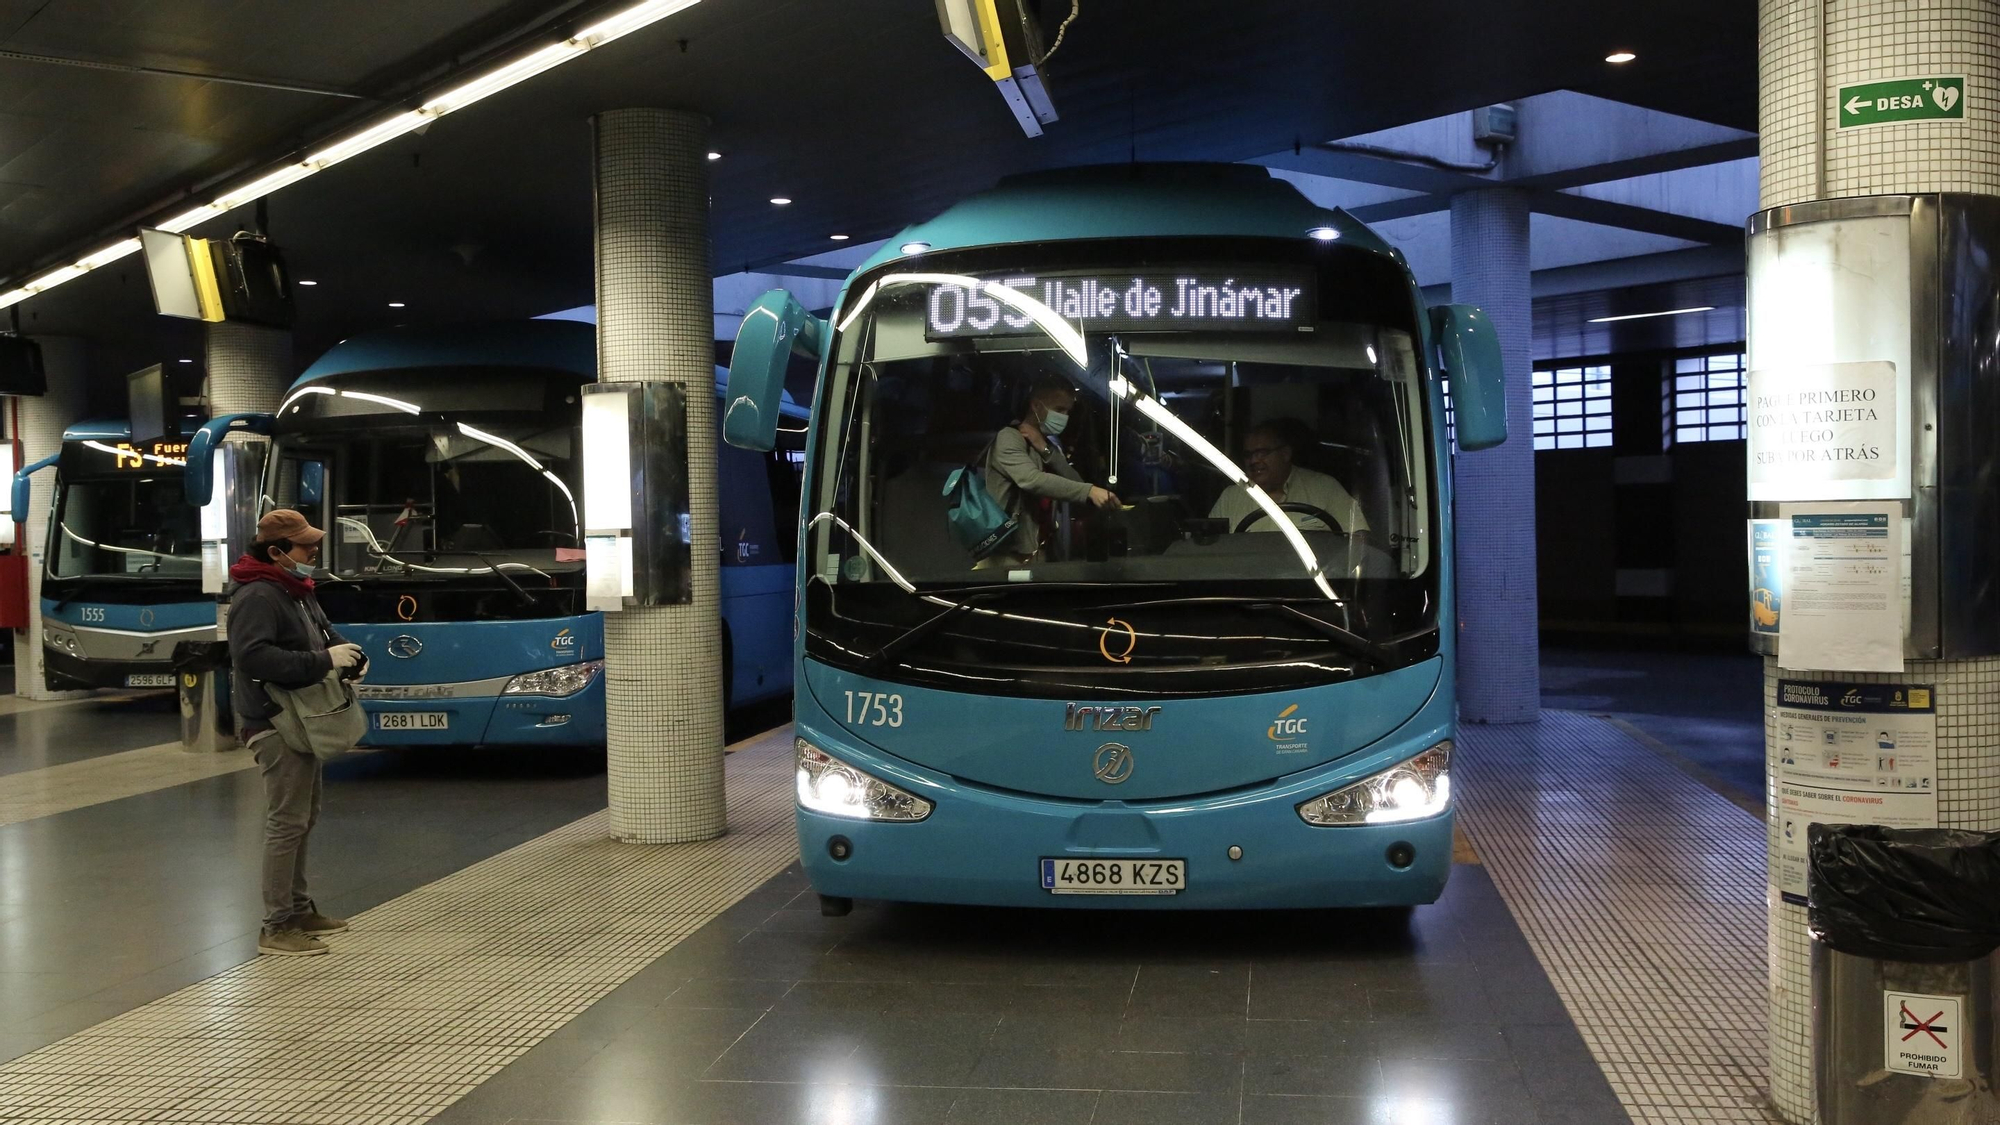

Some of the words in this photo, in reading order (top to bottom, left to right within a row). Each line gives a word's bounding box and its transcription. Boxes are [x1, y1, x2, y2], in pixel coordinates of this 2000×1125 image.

[1877, 95, 1924, 111] DESA
[931, 277, 1036, 333] 055
[1125, 278, 1161, 317] de
[1171, 278, 1301, 318] Jinámar
[1757, 394, 1795, 409] PAGE
[1799, 387, 1877, 405] PRIMERO
[1756, 413, 1777, 429] CON
[1802, 407, 1879, 424] TARJETA
[1782, 429, 1835, 445] LUEGO
[154, 443, 188, 455] Fuer
[1788, 449, 1816, 463] POR
[1821, 443, 1880, 462] ATRÁS
[81, 607, 105, 622] 1555
[554, 636, 575, 646] TGC
[130, 675, 154, 686] 2596
[1783, 684, 1820, 697] PROTOCOLO
[1842, 694, 1863, 704] TGC
[1783, 693, 1829, 706] CORONAVIRUS
[844, 690, 904, 728] 1753
[382, 714, 415, 728] 2681
[420, 714, 446, 728] LDK
[1798, 713, 1823, 722] GENERALES
[1831, 715, 1867, 724] PREVENCIÓN
[1273, 718, 1308, 735] TGC
[1275, 742, 1309, 750] TRANSPORTE
[1802, 790, 1817, 799] SABER
[1818, 793, 1835, 801] SOBRE
[1835, 794, 1842, 802] EL
[1842, 795, 1883, 805] CORONAVIRUS
[1060, 862, 1123, 884] 4868
[1132, 863, 1179, 885] KZS
[1900, 1051, 1947, 1064] PROHIBIDO
[1908, 1061, 1939, 1071] FUMAR
